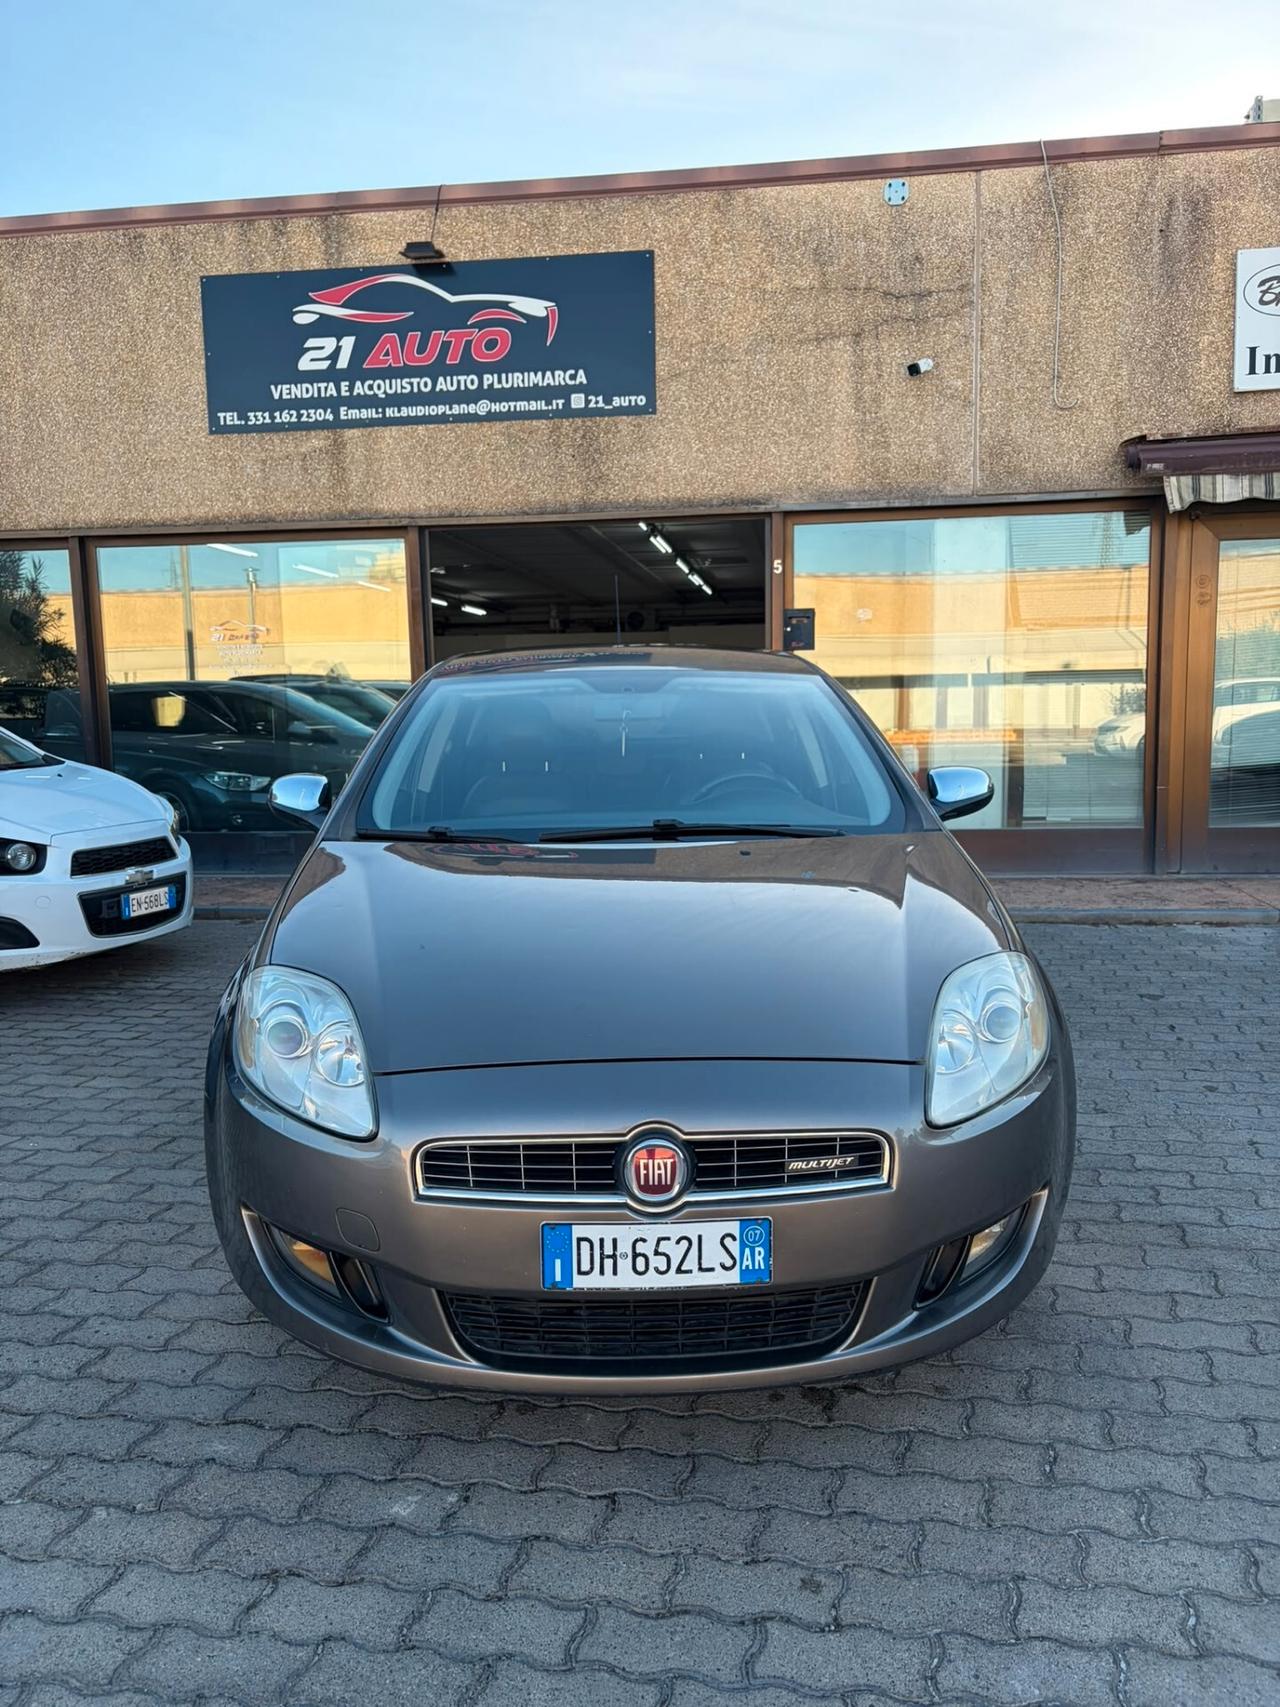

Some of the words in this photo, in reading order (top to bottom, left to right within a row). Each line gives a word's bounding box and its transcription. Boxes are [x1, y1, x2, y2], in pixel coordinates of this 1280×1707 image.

[297, 335, 356, 371] 21
[363, 327, 512, 368] AUTO
[270, 383, 337, 400] VENDITA
[340, 382, 350, 397] E
[353, 377, 432, 398] ACQUISTO
[435, 374, 479, 392] AUTO
[483, 369, 588, 389] PLURIMARCA
[217, 411, 245, 426] TEL.
[247, 411, 271, 425] 331
[274, 410, 298, 423] 162
[300, 408, 334, 422] 2304
[773, 559, 783, 574] 5
[131, 897, 142, 913] EN
[639, 1158, 674, 1186] FIAT
[788, 1157, 855, 1170] MULTIJET
[748, 1230, 761, 1242] 07
[576, 1236, 618, 1276] DH
[631, 1232, 737, 1277] 652LS
[742, 1248, 765, 1270] AR
